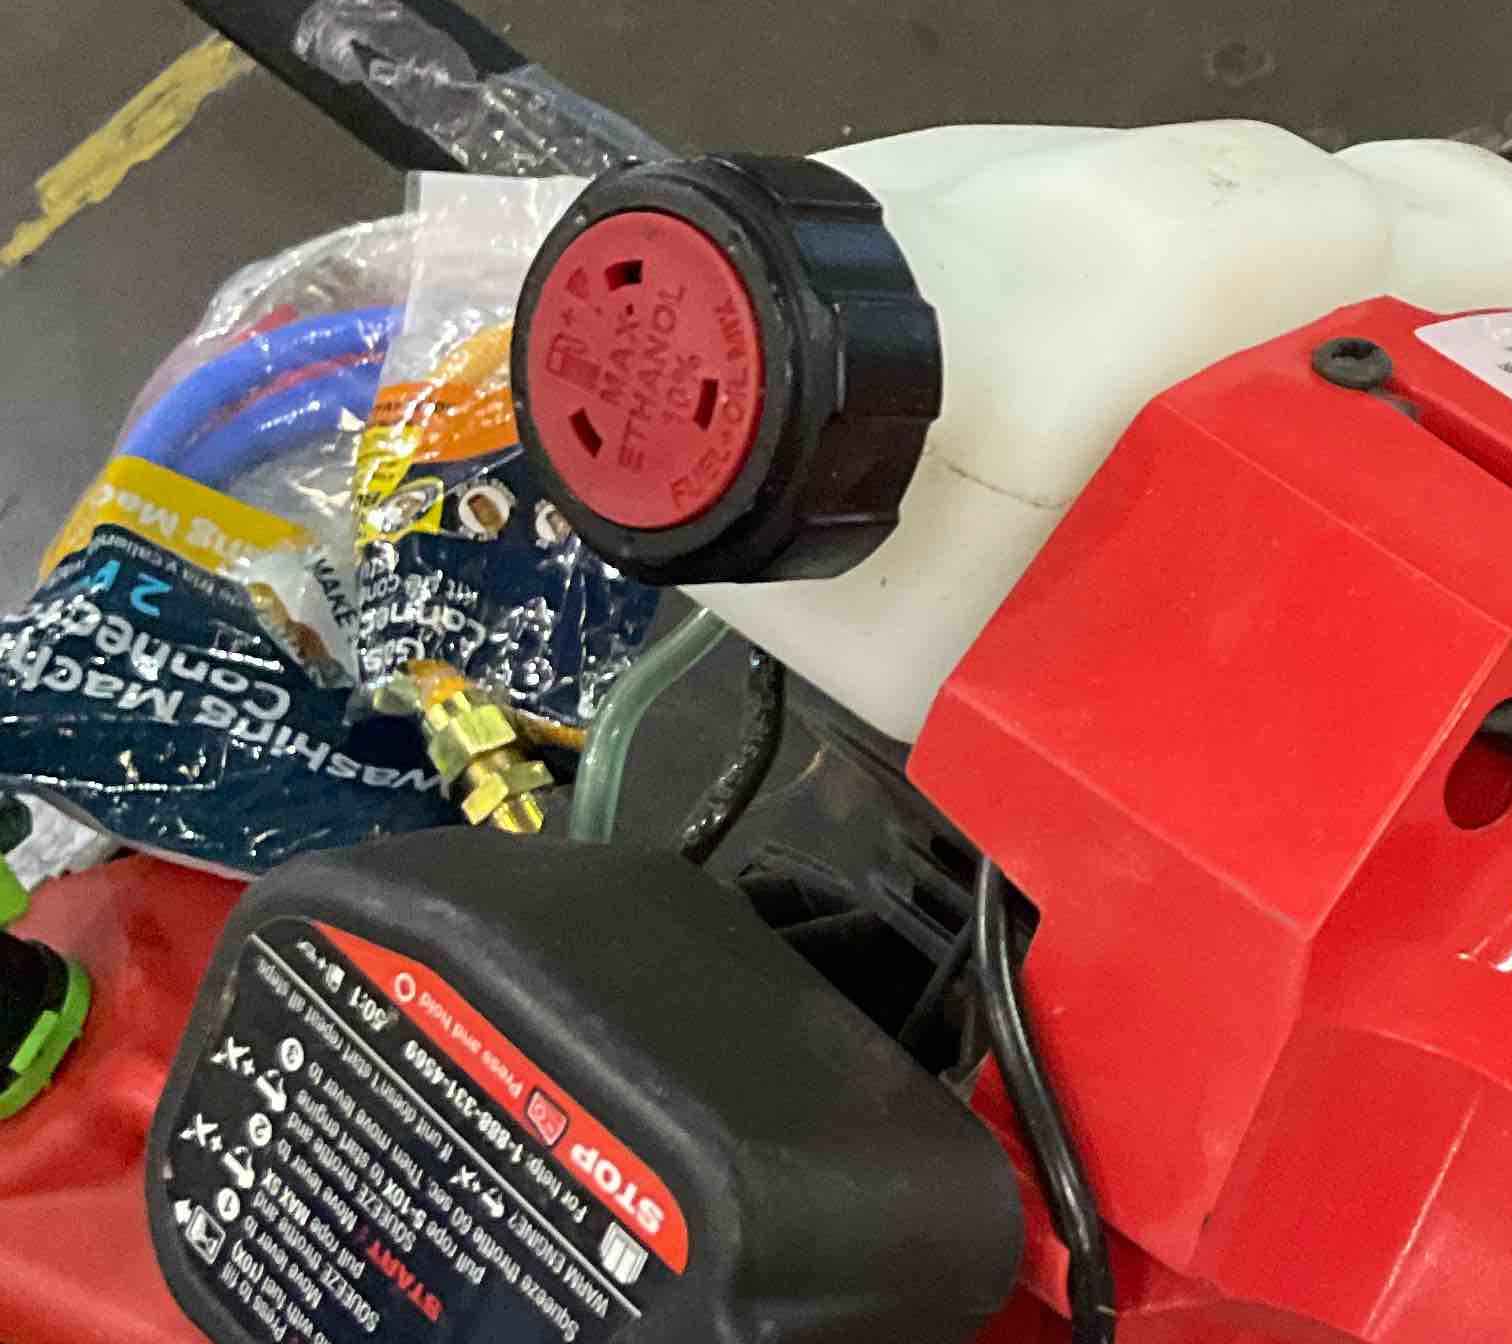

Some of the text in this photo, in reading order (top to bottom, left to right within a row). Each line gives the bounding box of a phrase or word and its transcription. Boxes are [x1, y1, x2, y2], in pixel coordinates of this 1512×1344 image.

[616, 281, 685, 473] ETHANOL
[127, 571, 174, 617] 2
[287, 990, 306, 1013] all
[348, 985, 391, 1032] 50:1
[303, 1005, 344, 1051] repeat
[307, 1061, 324, 1086] to
[341, 1043, 373, 1079] start
[321, 1077, 357, 1119] lever
[370, 1071, 417, 1124] doesn't
[418, 989, 672, 1240] STOP Press and hold
[276, 1137, 292, 1163] to
[354, 1108, 392, 1151] move
[414, 1116, 443, 1149] unit
[285, 1111, 417, 1253] SQUEEZE throttle and
[289, 1154, 323, 1196] lever
[295, 1088, 487, 1285] pull rope 5-10X to start engine
[390, 1143, 424, 1190] Then
[278, 1186, 311, 1226] MAX
[321, 1186, 358, 1233] Move
[450, 1206, 473, 1236] 60
[559, 1189, 588, 1224] For
[308, 1216, 340, 1253] rope
[472, 1226, 521, 1284] throttle
[507, 1211, 566, 1274] ENGINE?
[219, 1261, 240, 1289] fill
[231, 1238, 265, 1284] (10X)
[243, 1215, 323, 1310] Move lever to
[250, 1189, 380, 1333] SQUEEZE throttle and
[336, 1247, 366, 1280] pull
[237, 1279, 253, 1303] to
[260, 1275, 287, 1310] fuel
[519, 1274, 580, 1343] Squeeze
[562, 1264, 609, 1318] WARM
[251, 1294, 288, 1343] Press
[285, 1301, 314, 1339] with
